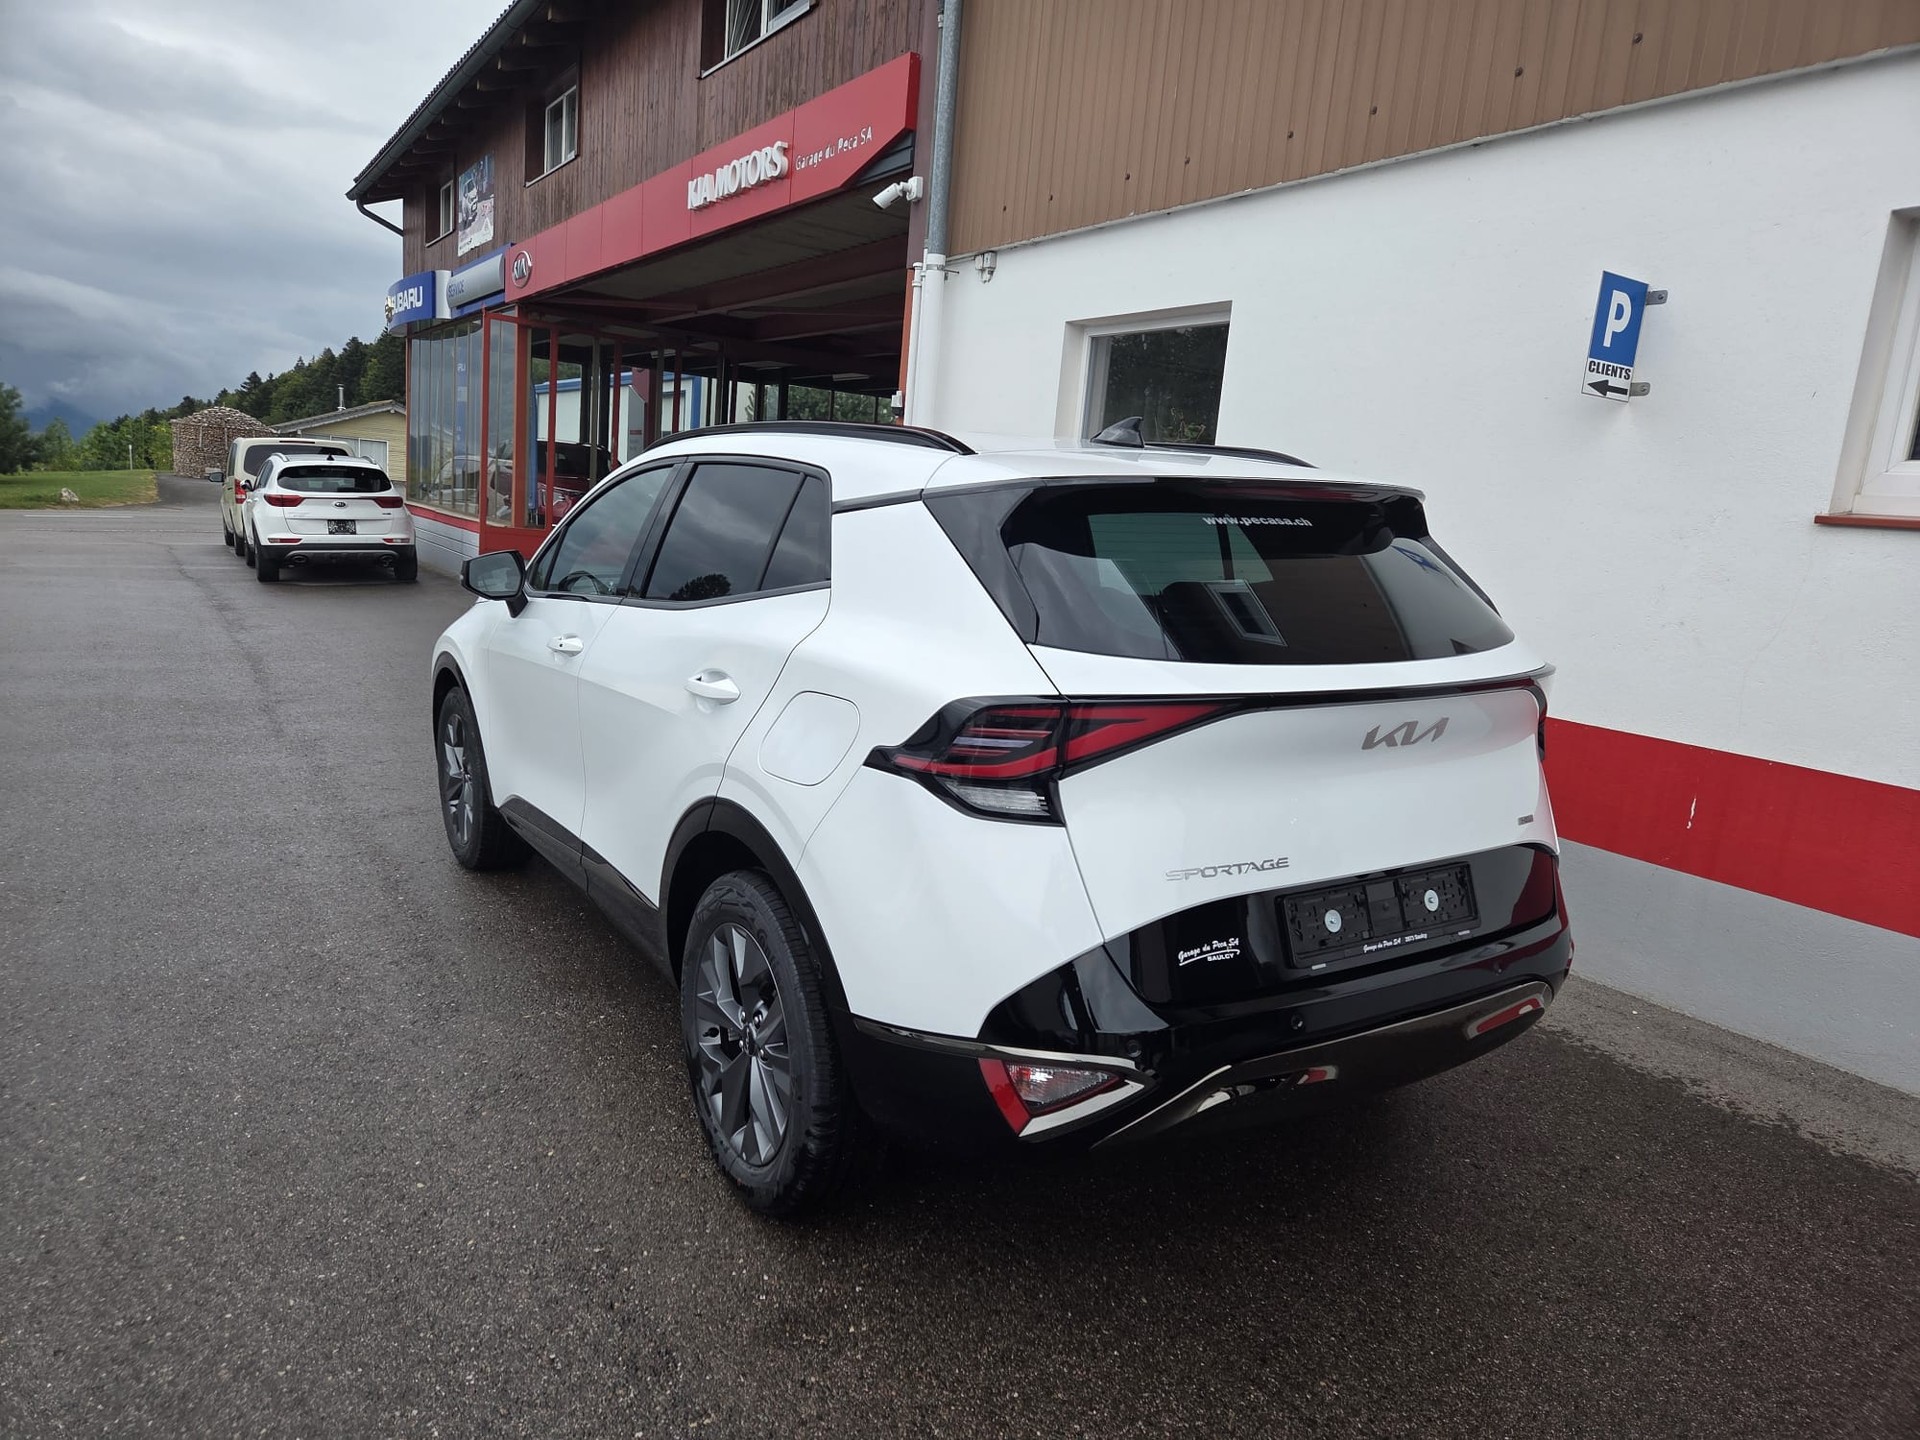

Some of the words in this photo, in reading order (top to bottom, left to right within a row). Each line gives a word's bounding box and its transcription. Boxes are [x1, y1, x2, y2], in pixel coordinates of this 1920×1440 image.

[796, 150, 823, 170] Garage
[825, 145, 835, 159] du
[838, 136, 858, 154] Peca
[860, 126, 872, 145] SA
[688, 173, 716, 209] KIA
[715, 141, 788, 199] MOTORS
[1603, 289, 1632, 348] P
[1588, 360, 1631, 380] CLIENTS
[1202, 517, 1313, 526] www.pecasa.ch
[1361, 717, 1449, 750] KIA
[1165, 857, 1289, 881] SPORTAGE
[1178, 948, 1200, 963] Garage
[1207, 953, 1234, 962] SAULCY
